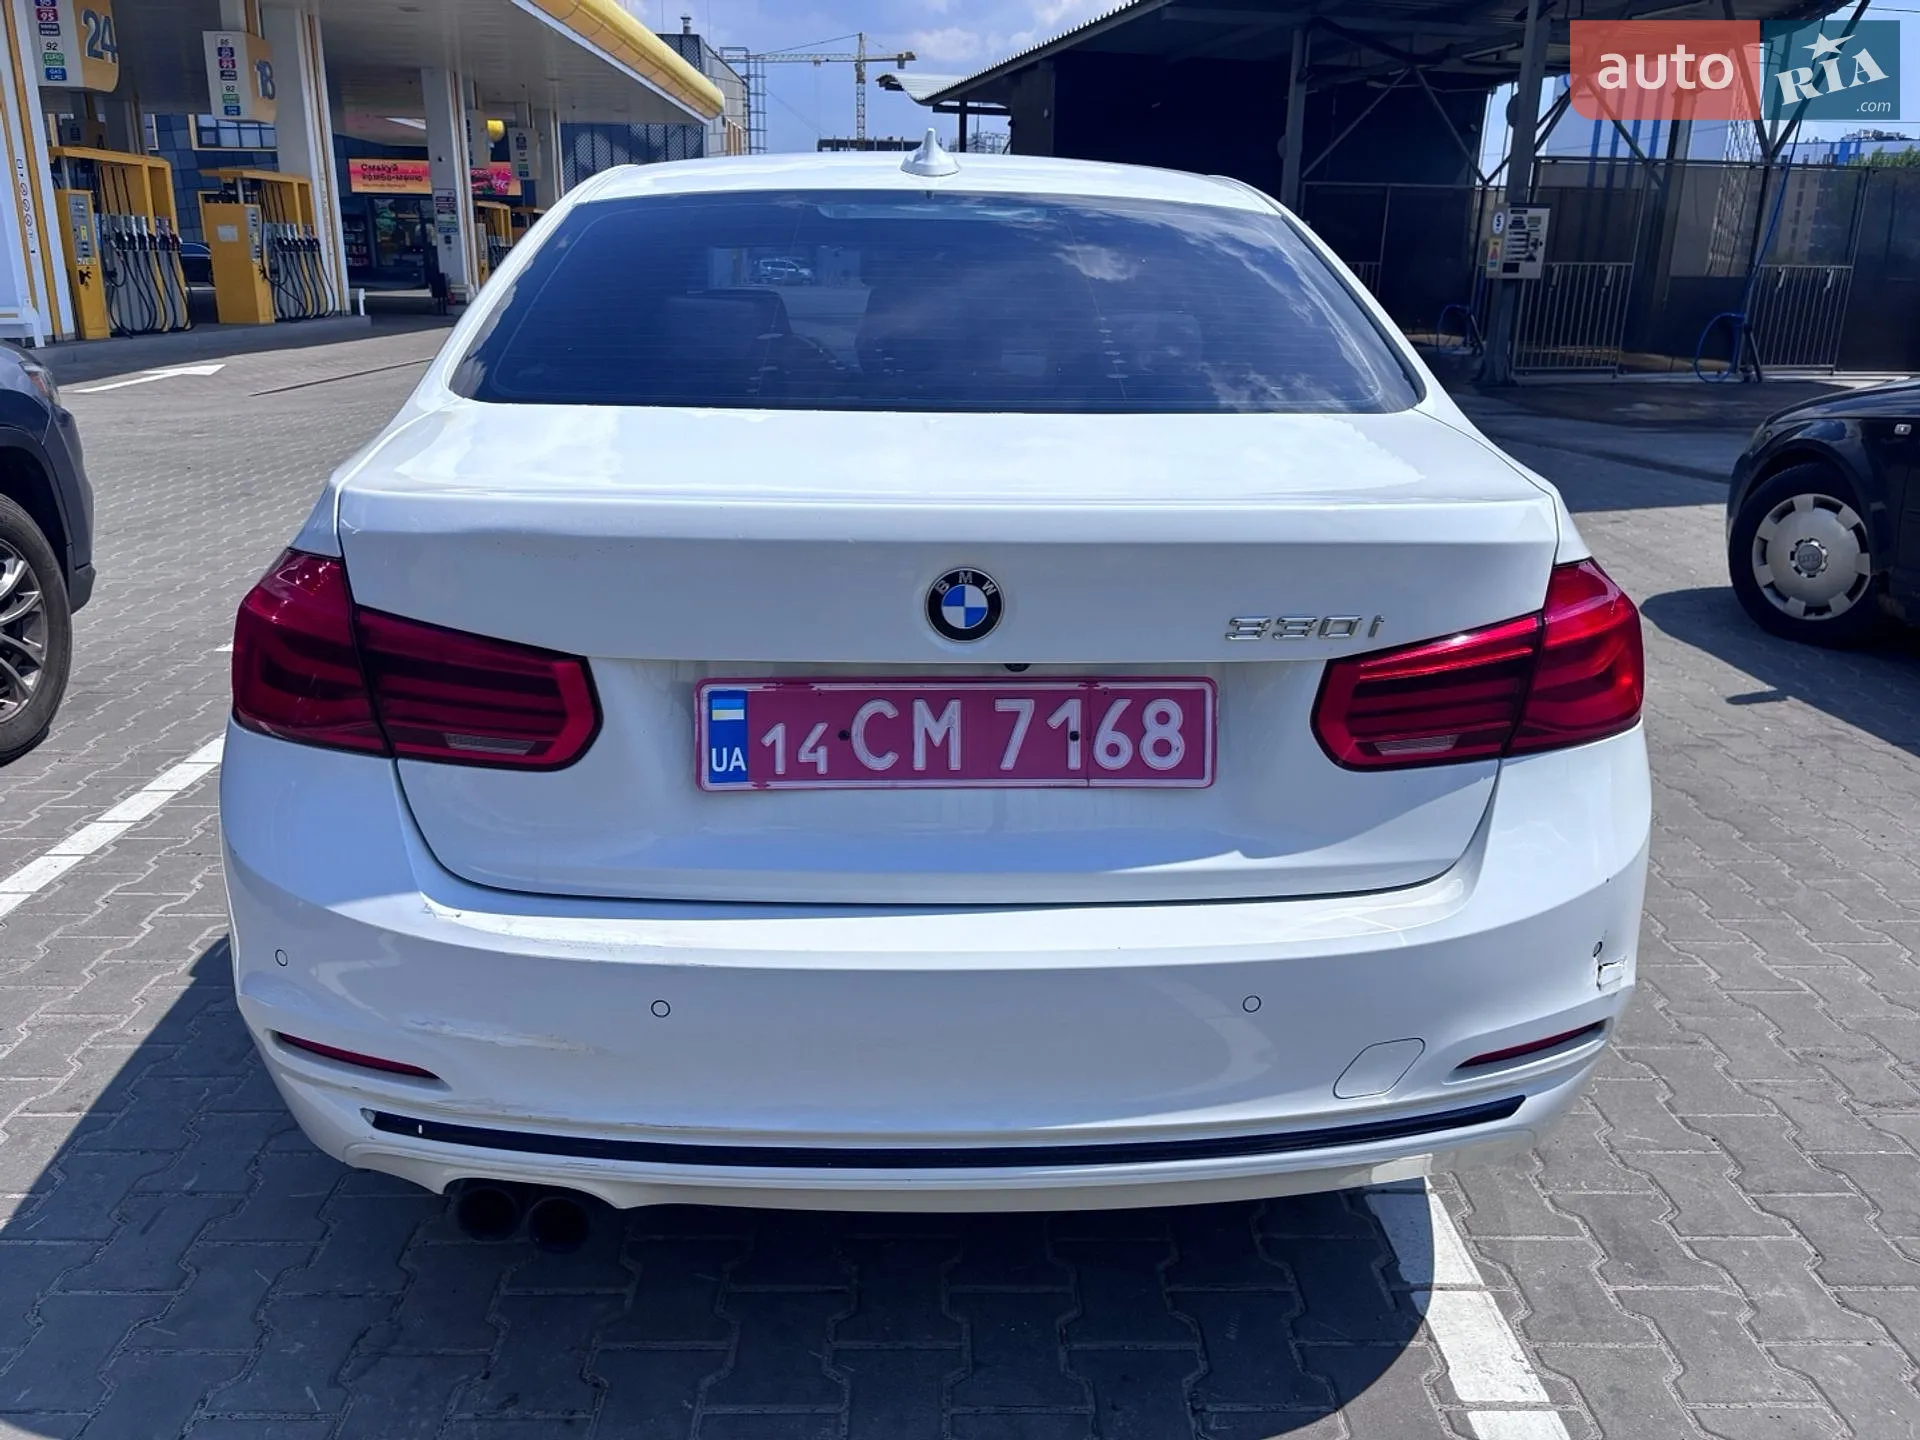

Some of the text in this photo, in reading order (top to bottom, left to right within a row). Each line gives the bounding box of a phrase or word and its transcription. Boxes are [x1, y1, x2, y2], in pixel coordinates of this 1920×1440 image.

[40, 12, 55, 21] 95
[45, 41, 58, 51] 92
[82, 10, 118, 64] 24
[254, 59, 276, 100] 18
[935, 571, 997, 596] BMW
[1225, 615, 1385, 640] 330i
[760, 722, 829, 775] 14
[995, 698, 1186, 771] 7168
[711, 747, 747, 772] UA
